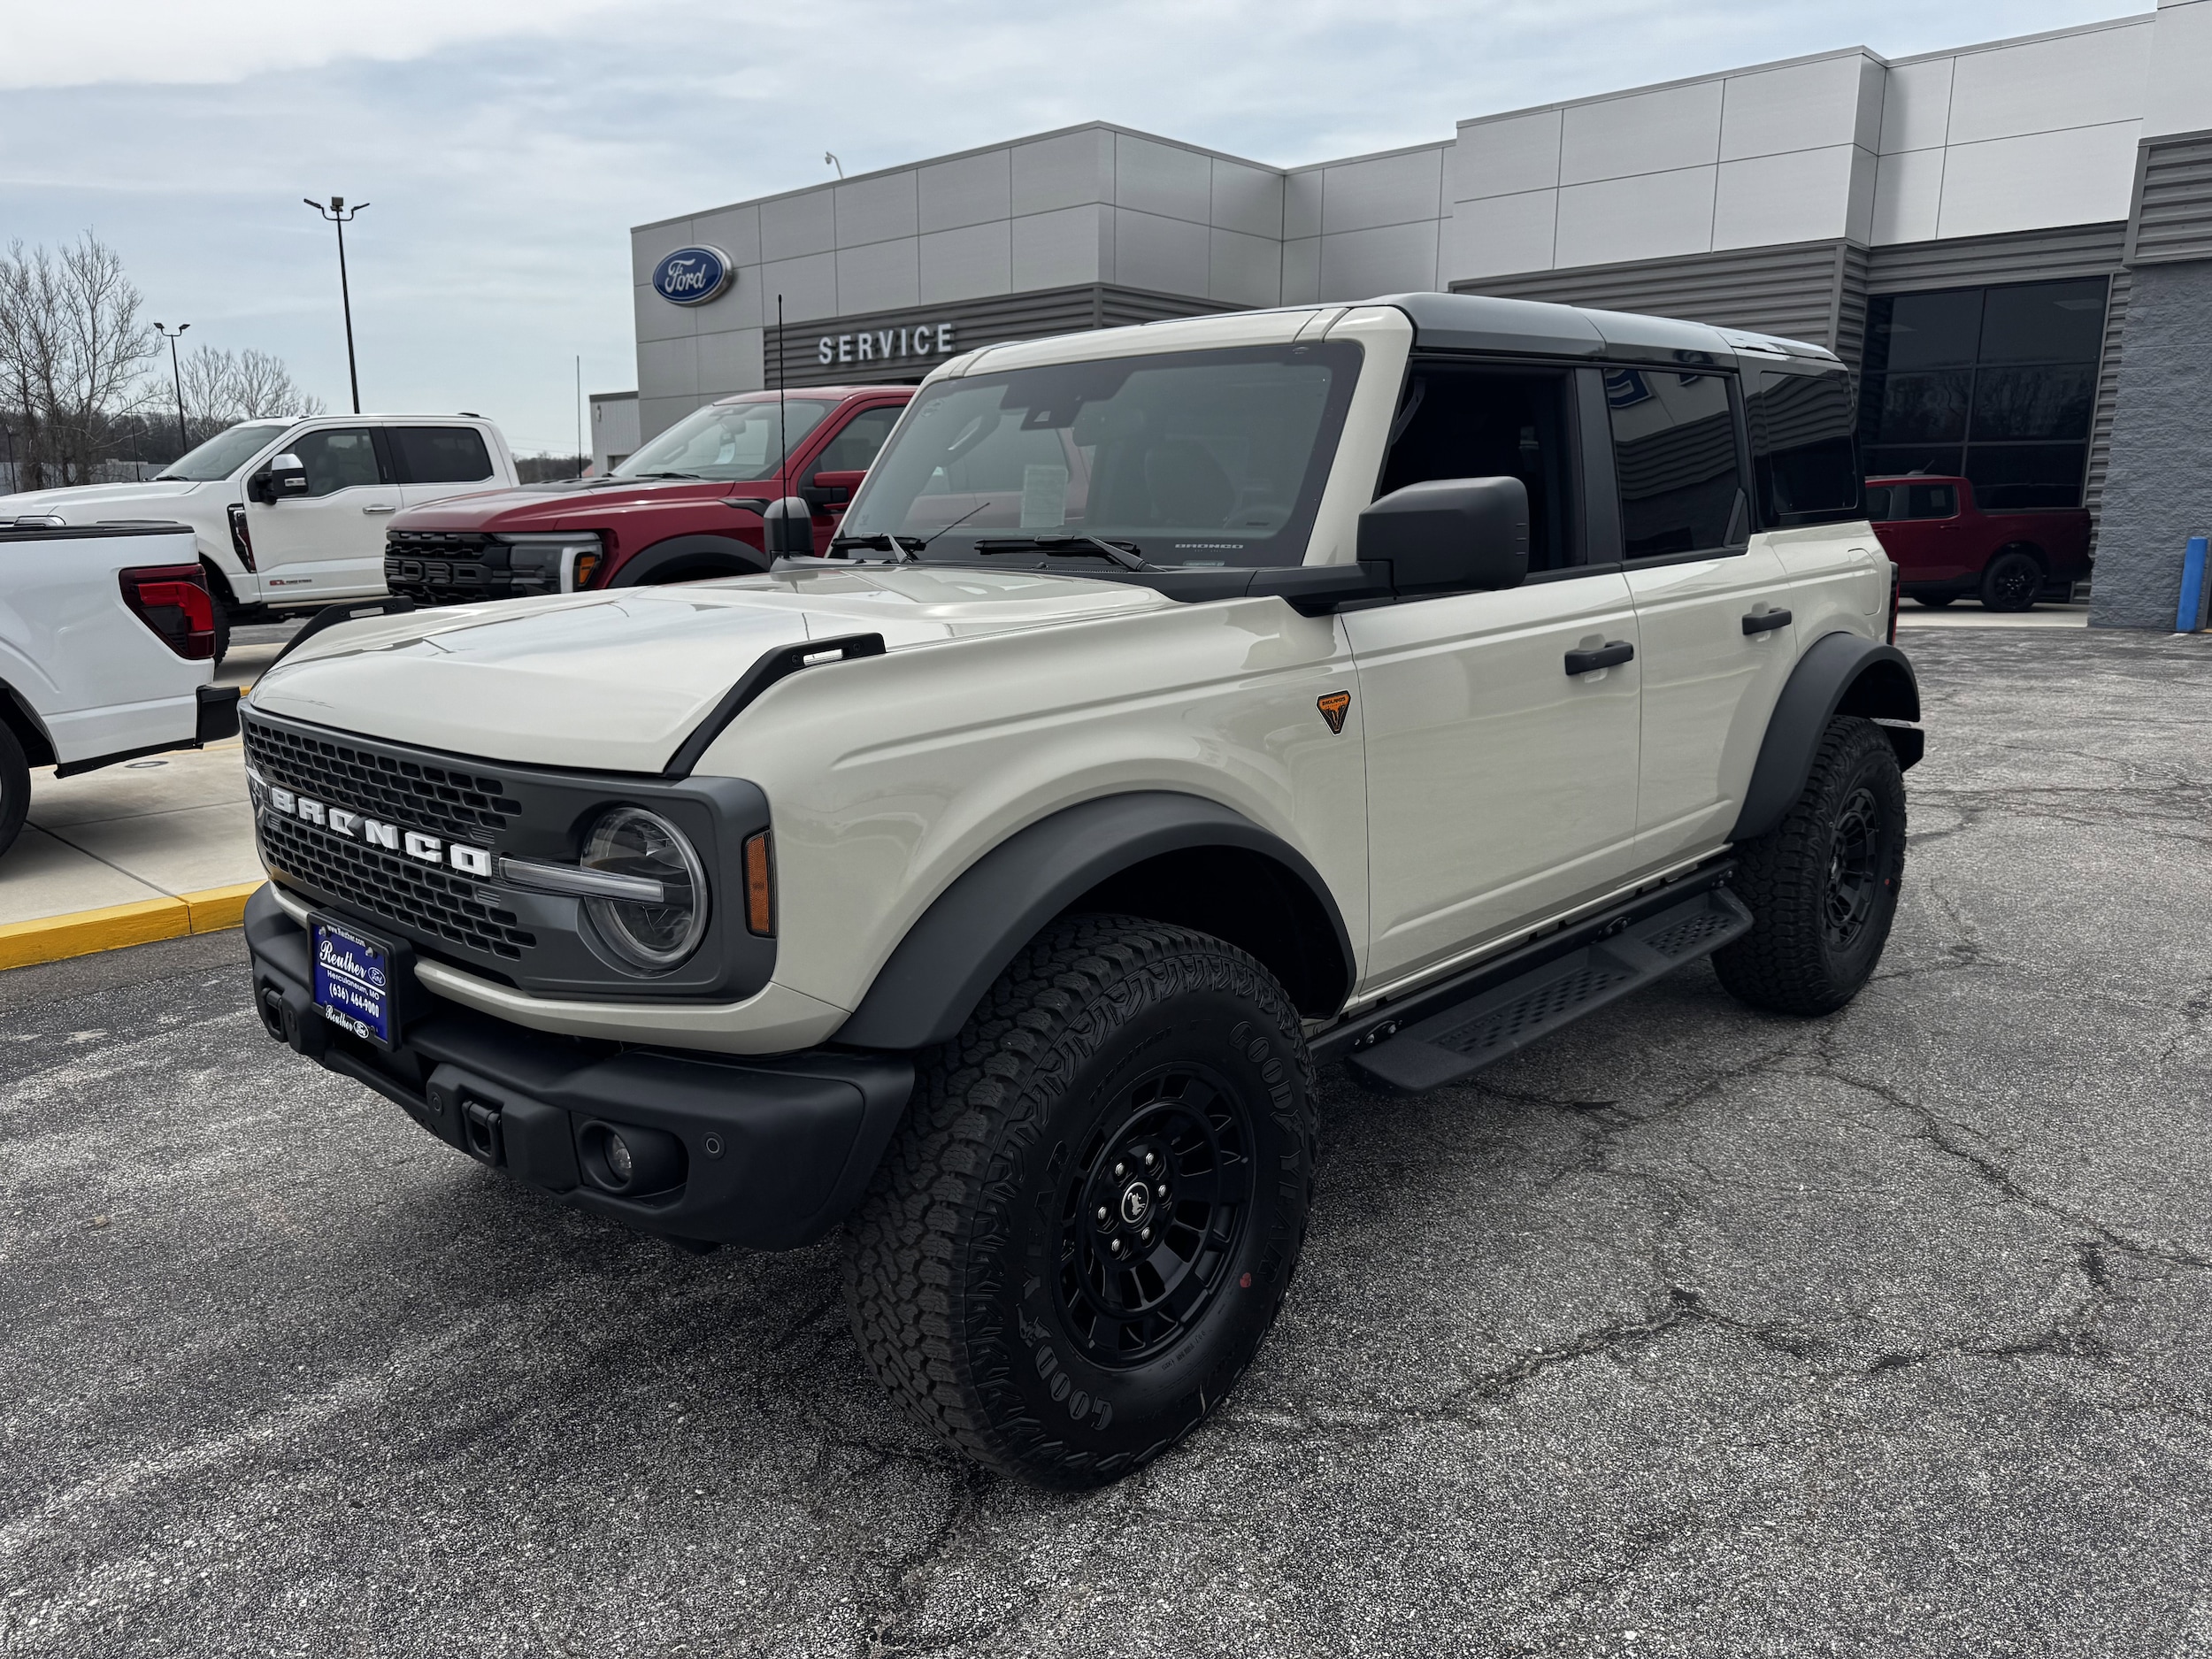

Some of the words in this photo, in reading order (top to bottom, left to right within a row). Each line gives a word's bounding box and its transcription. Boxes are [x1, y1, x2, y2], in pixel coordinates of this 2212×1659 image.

[664, 257, 707, 294] Ford
[818, 323, 954, 364] SERVICE
[271, 786, 492, 878] BRONCO
[319, 941, 367, 979] Reuther
[327, 970, 368, 996] Herculaneum,
[369, 988, 380, 1001] MO
[329, 982, 349, 1004] (636)
[350, 991, 380, 1018] 464-9000
[326, 1004, 353, 1032] Reuther
